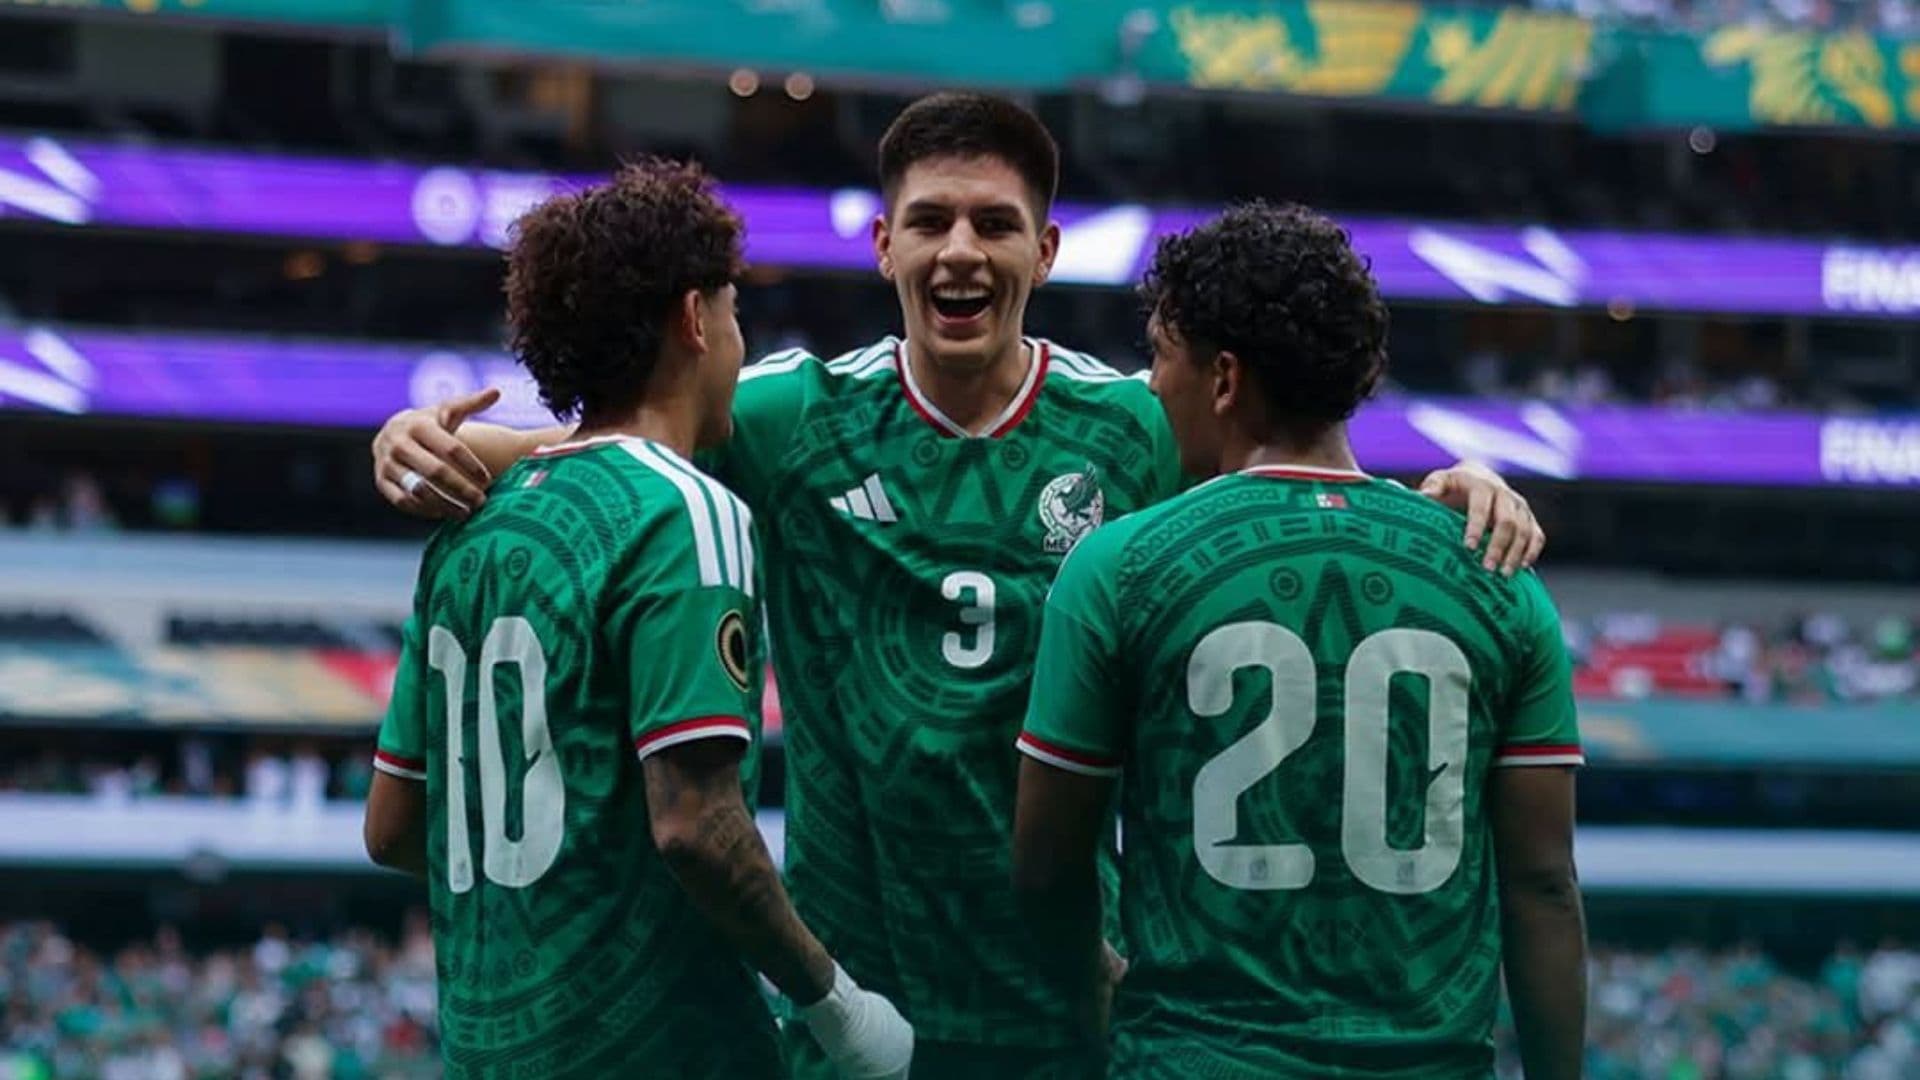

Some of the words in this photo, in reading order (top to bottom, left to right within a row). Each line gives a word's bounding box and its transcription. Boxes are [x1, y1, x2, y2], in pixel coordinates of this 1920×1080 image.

[428, 616, 565, 894] 10
[941, 571, 996, 669] 3
[1187, 621, 1472, 894] 20
